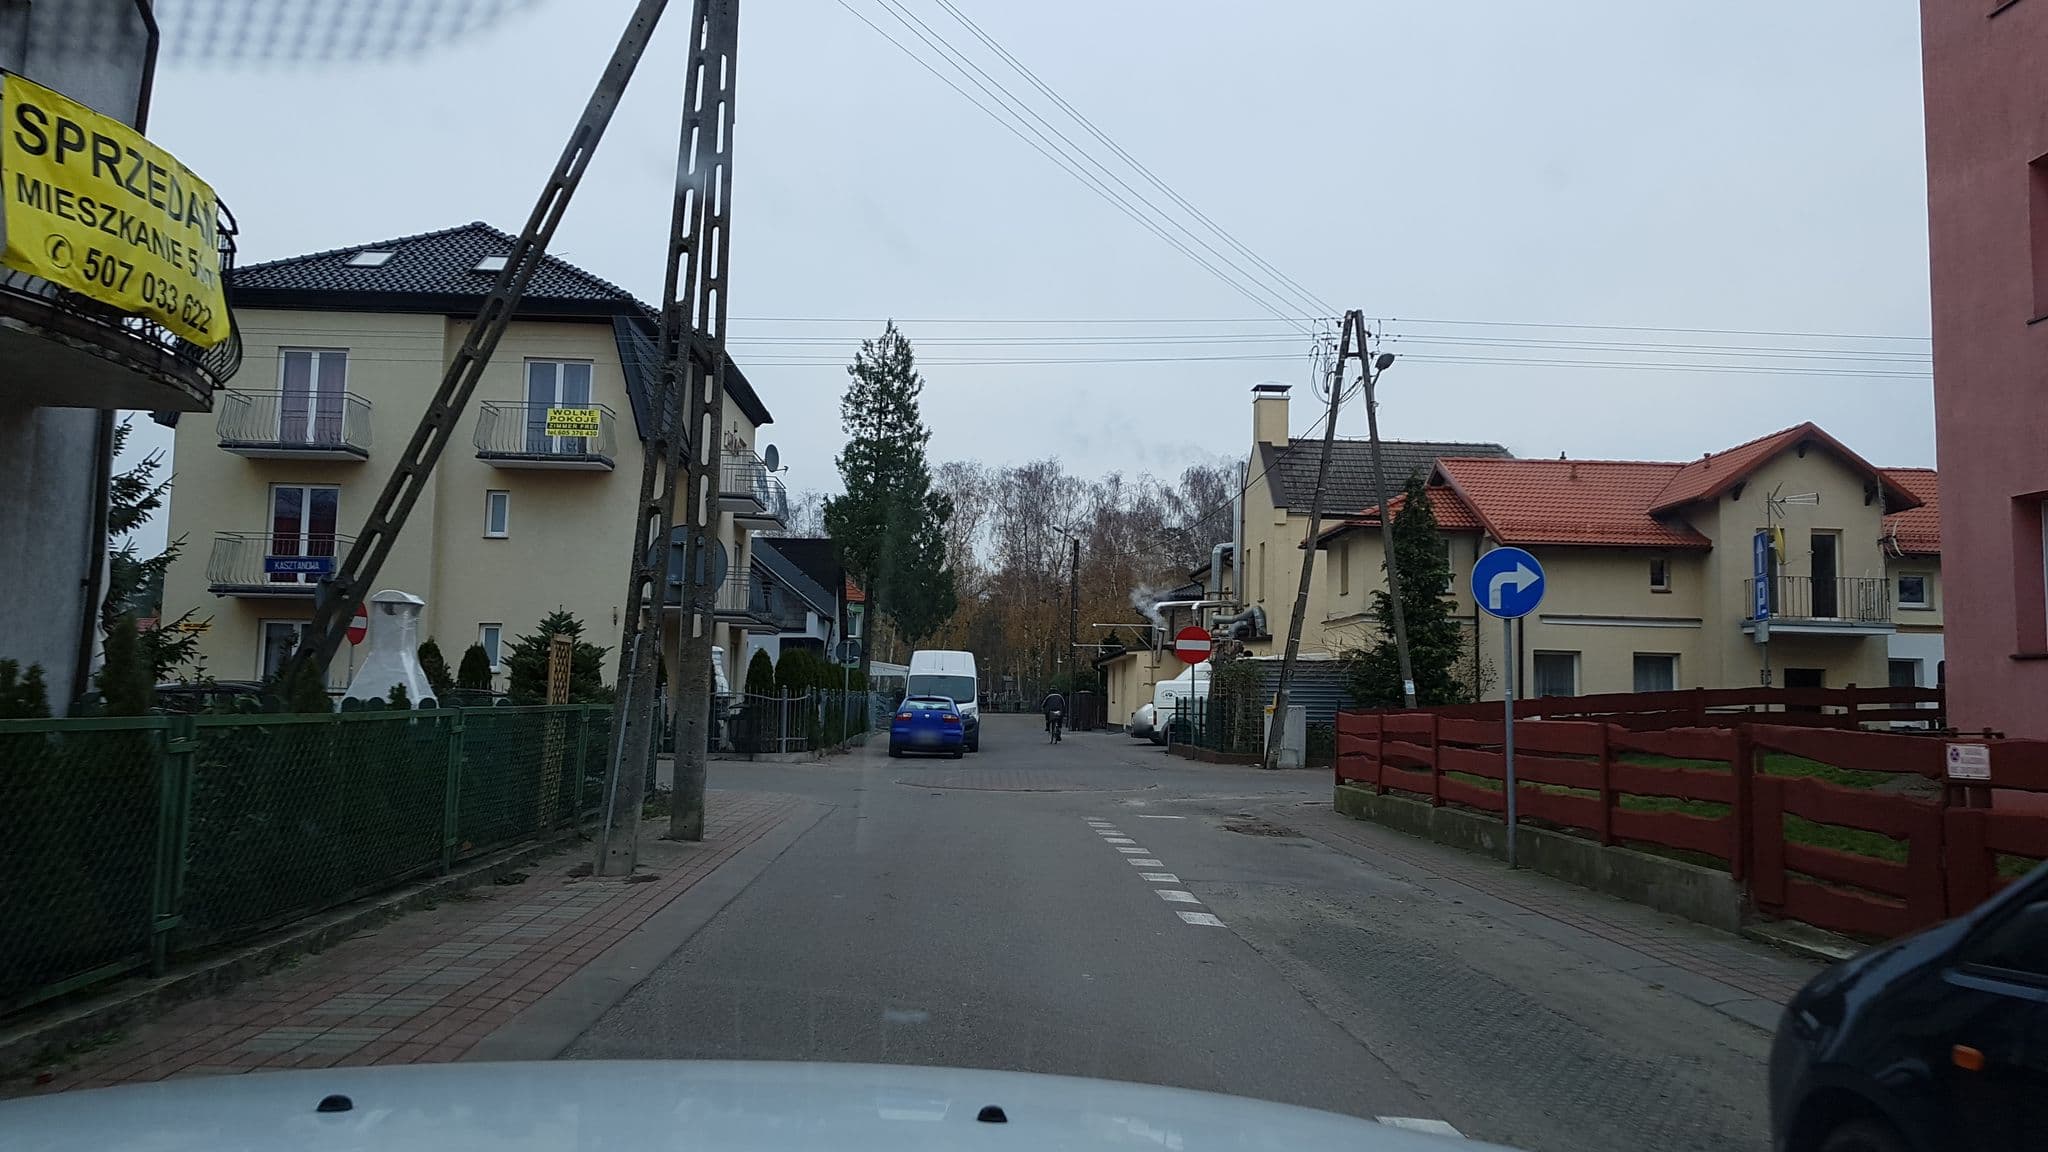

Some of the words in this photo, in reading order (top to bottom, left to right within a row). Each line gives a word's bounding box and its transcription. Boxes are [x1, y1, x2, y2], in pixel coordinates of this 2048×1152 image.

[16, 172, 183, 270] MIESZKANIE
[82, 246, 134, 294] 507
[142, 271, 178, 315] 033
[181, 292, 213, 334] 622
[274, 560, 320, 570] KASZTANOWA
